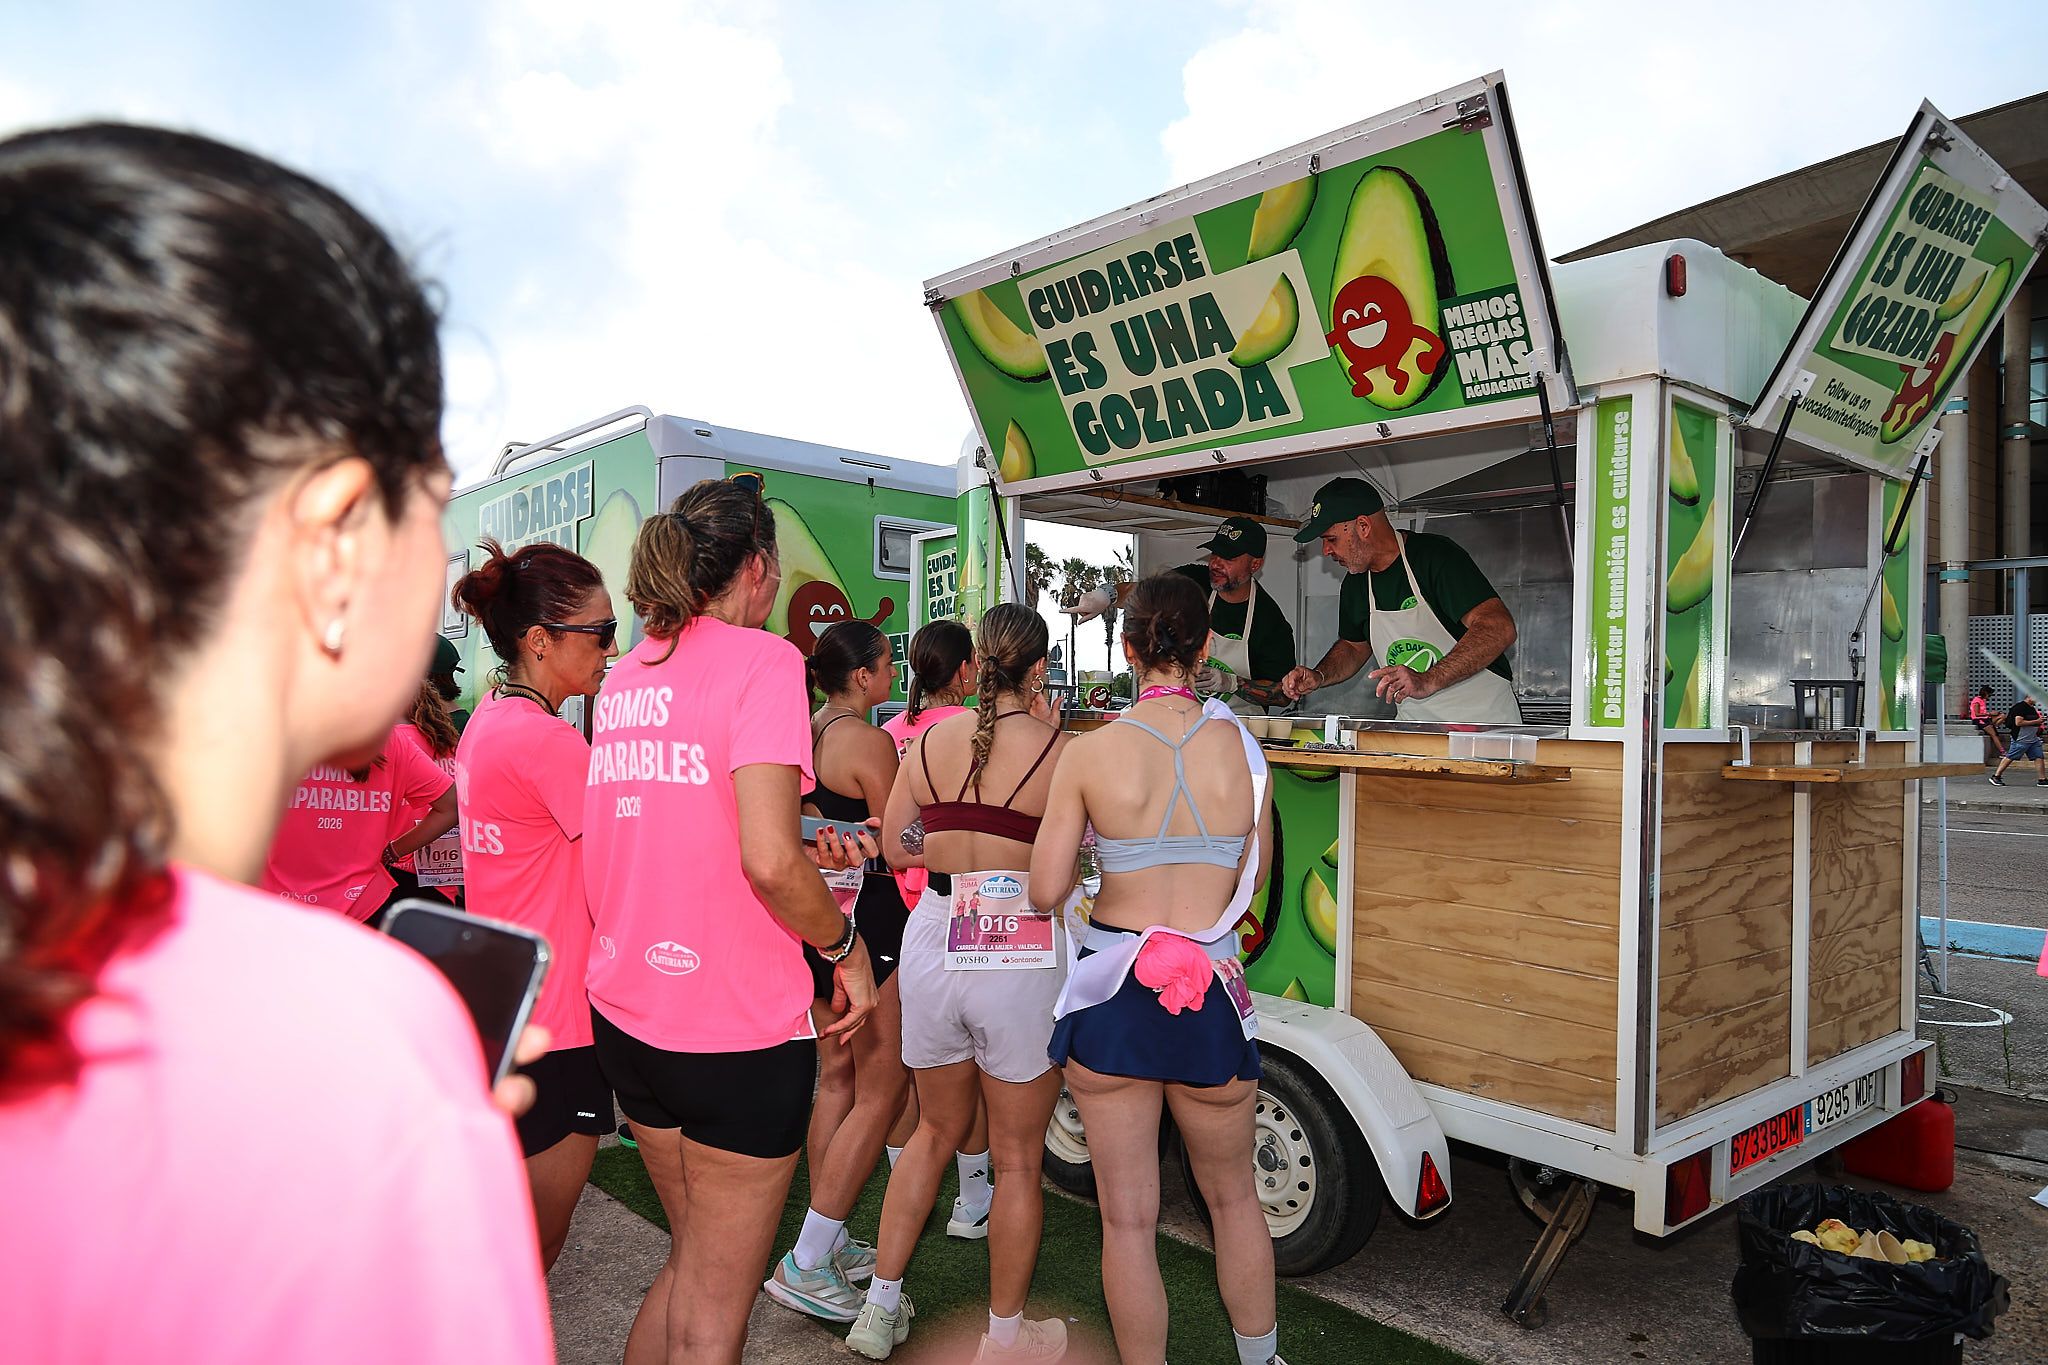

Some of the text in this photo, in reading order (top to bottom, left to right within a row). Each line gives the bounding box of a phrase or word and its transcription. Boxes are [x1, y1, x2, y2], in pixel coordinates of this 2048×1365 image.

[1909, 182, 1991, 247] CUIDARSE
[1027, 233, 1205, 330] CUIDARSE
[1871, 232, 1966, 304] ES UNA
[1443, 293, 1519, 328] MENOS
[1843, 293, 1943, 362] GOZADA
[1046, 293, 1238, 395] ES UNA
[1449, 317, 1525, 350] REGLAS
[1455, 340, 1531, 385] MÁS
[1071, 361, 1291, 455] GOZADA
[1824, 378, 1871, 412] Follow us on
[481, 466, 591, 543] CUIDARSE
[1603, 411, 1629, 718] Disfrutar también es cuidarse
[928, 576, 943, 598] ES
[1389, 644, 1404, 659] NICE
[1406, 643, 1424, 652] DAY
[596, 686, 673, 733] SOMOS
[289, 787, 392, 812] PARABLES
[317, 817, 343, 830] 2026
[432, 850, 459, 862] 016
[960, 881, 978, 889] SUMA
[981, 884, 1020, 894] ASTURIANA
[979, 915, 1019, 933] 016
[650, 950, 695, 969] ASTURIANA
[956, 956, 1043, 964] OYSHO Santander
[1817, 1085, 1850, 1126] 9295
[1855, 1073, 1873, 1110] MDF
[1731, 1107, 1800, 1169] 6733BDM
